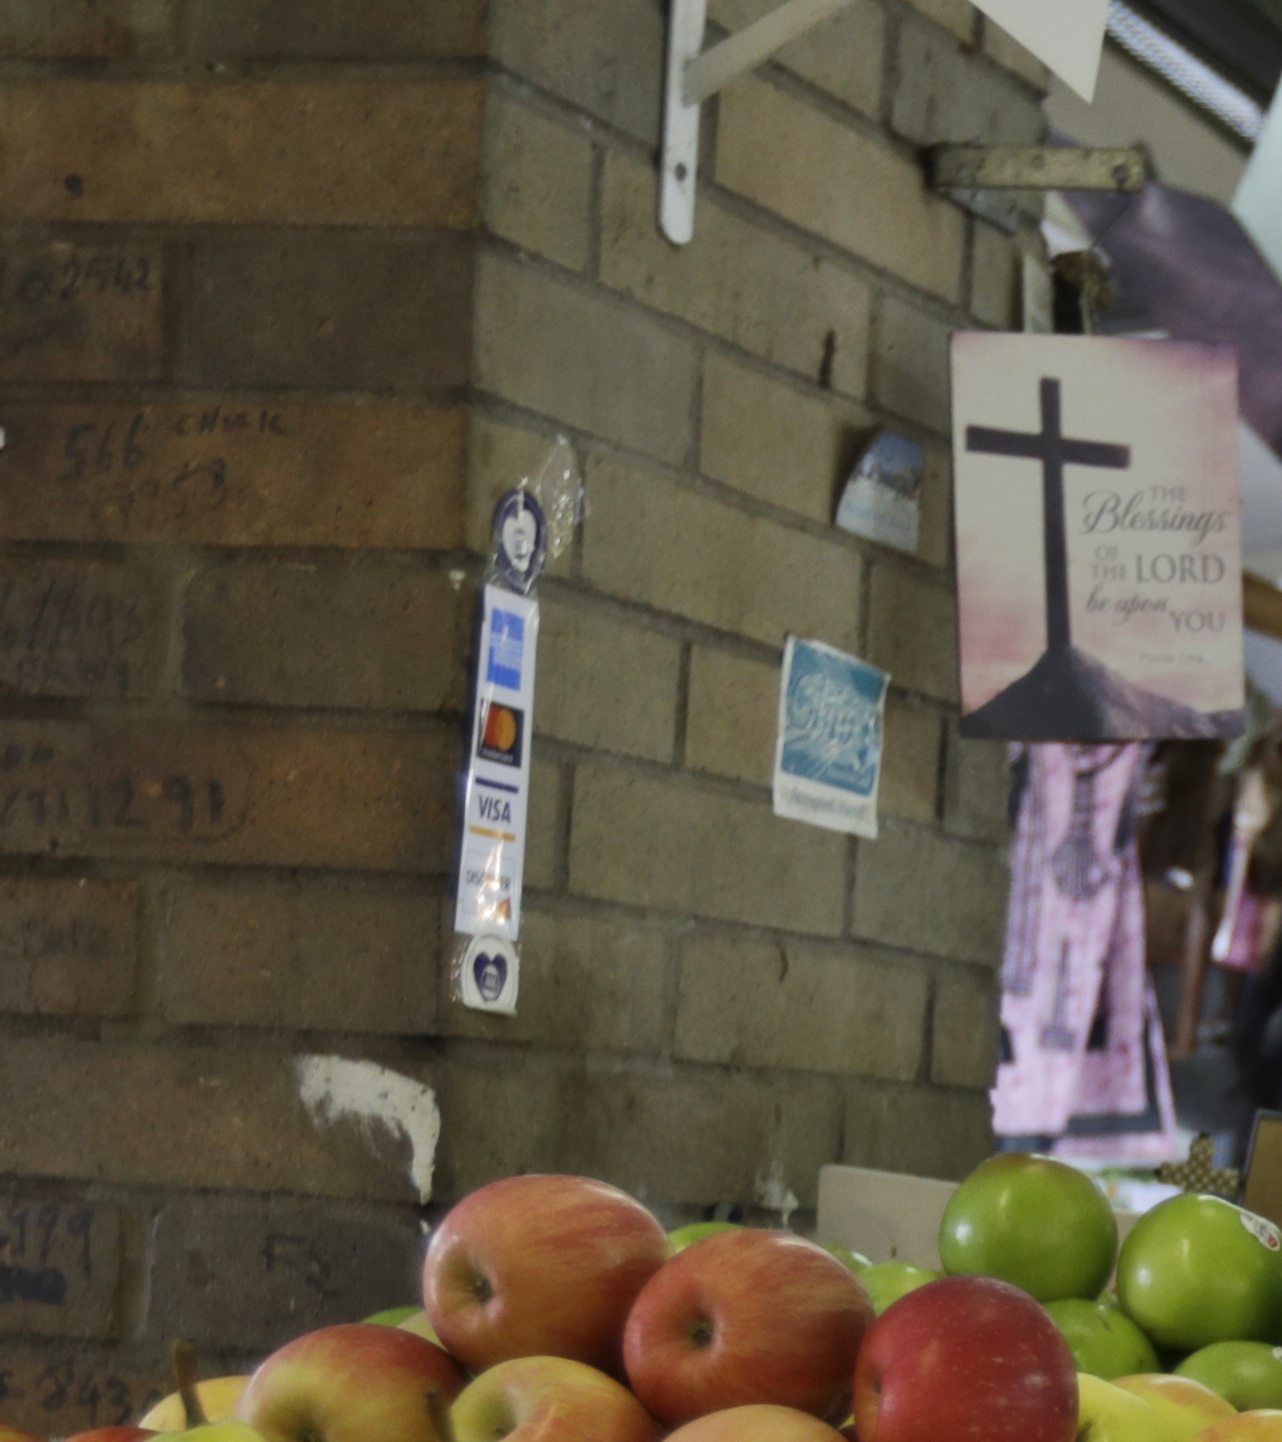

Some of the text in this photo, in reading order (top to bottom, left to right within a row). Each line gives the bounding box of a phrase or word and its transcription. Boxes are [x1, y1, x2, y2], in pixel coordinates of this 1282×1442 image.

[1151, 485, 1185, 501] THE
[1079, 490, 1229, 547] Blessings
[1091, 553, 1225, 584] THE LORD
[1085, 582, 1169, 627] be upon
[1169, 611, 1226, 632] YOU
[477, 794, 513, 824] VISA
[465, 868, 512, 891] DISCER
